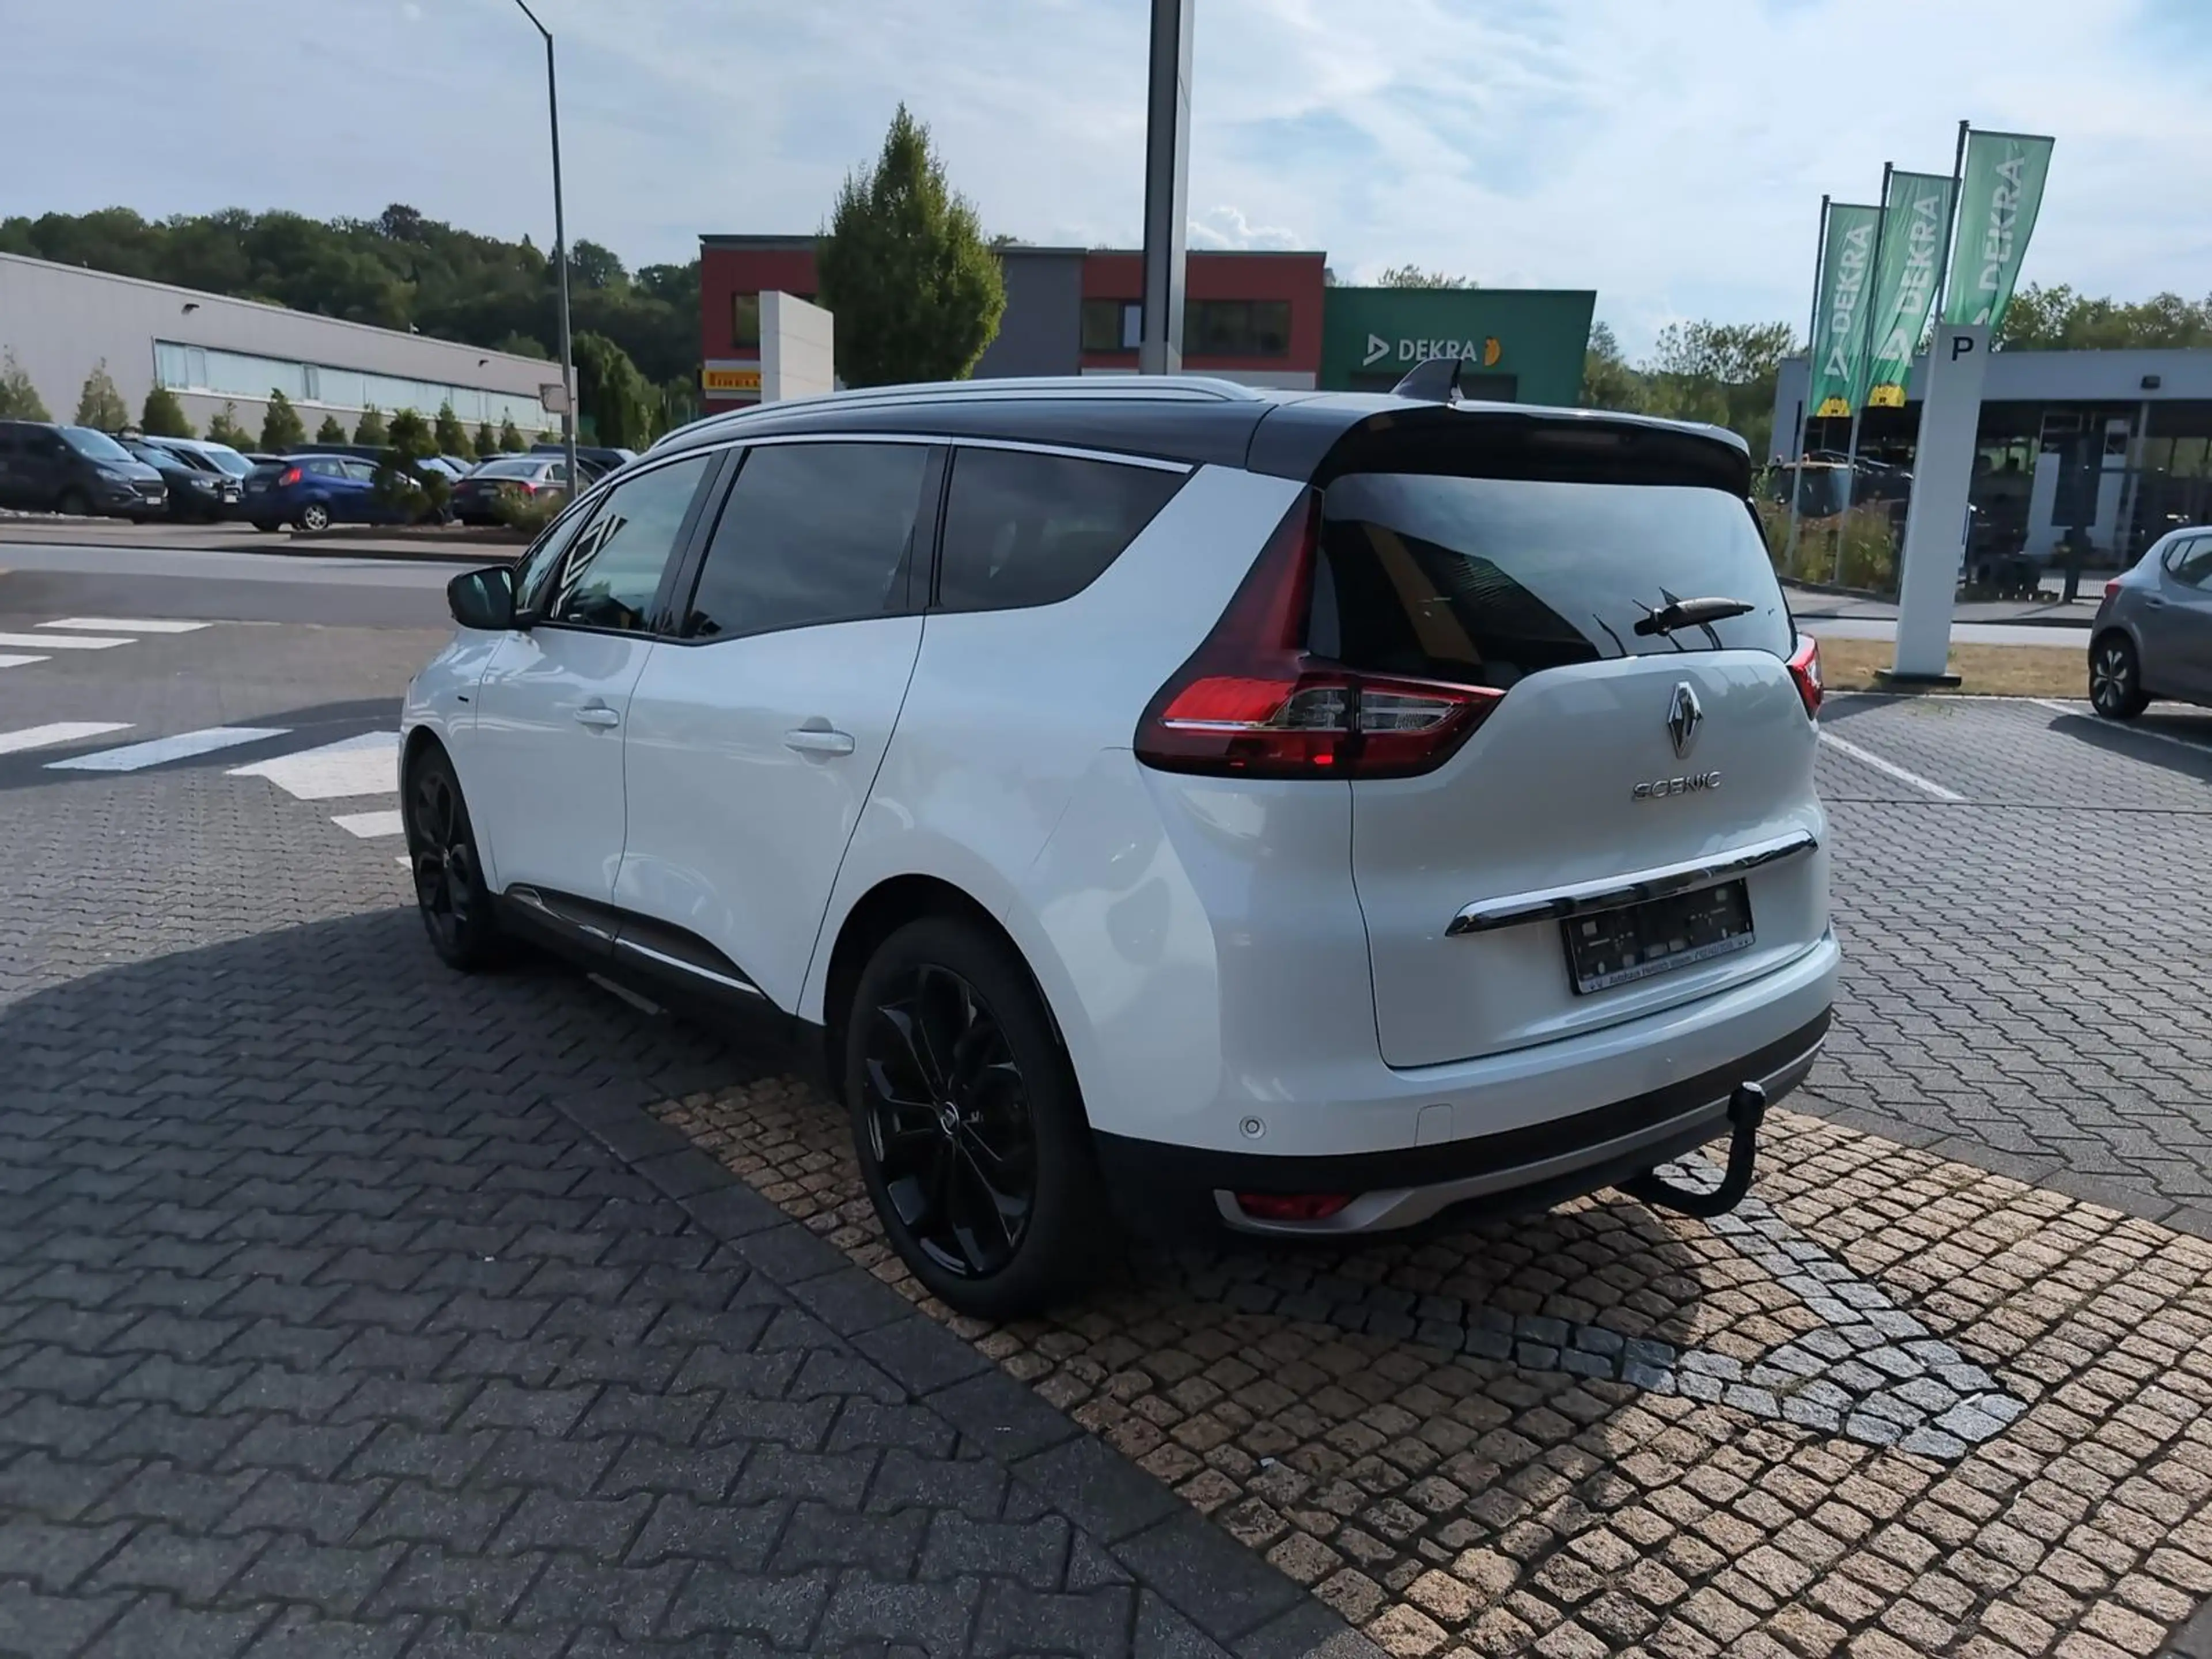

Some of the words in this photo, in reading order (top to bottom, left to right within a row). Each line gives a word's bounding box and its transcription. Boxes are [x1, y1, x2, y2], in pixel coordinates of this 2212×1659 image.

[1895, 195, 1940, 314] DEKRA
[1979, 157, 2025, 290] DEKRA
[1831, 224, 1873, 333] DEKRA
[1399, 339, 1478, 362] DEKRA
[1952, 336, 1974, 361] P
[1633, 771, 1722, 800] SCENIC
